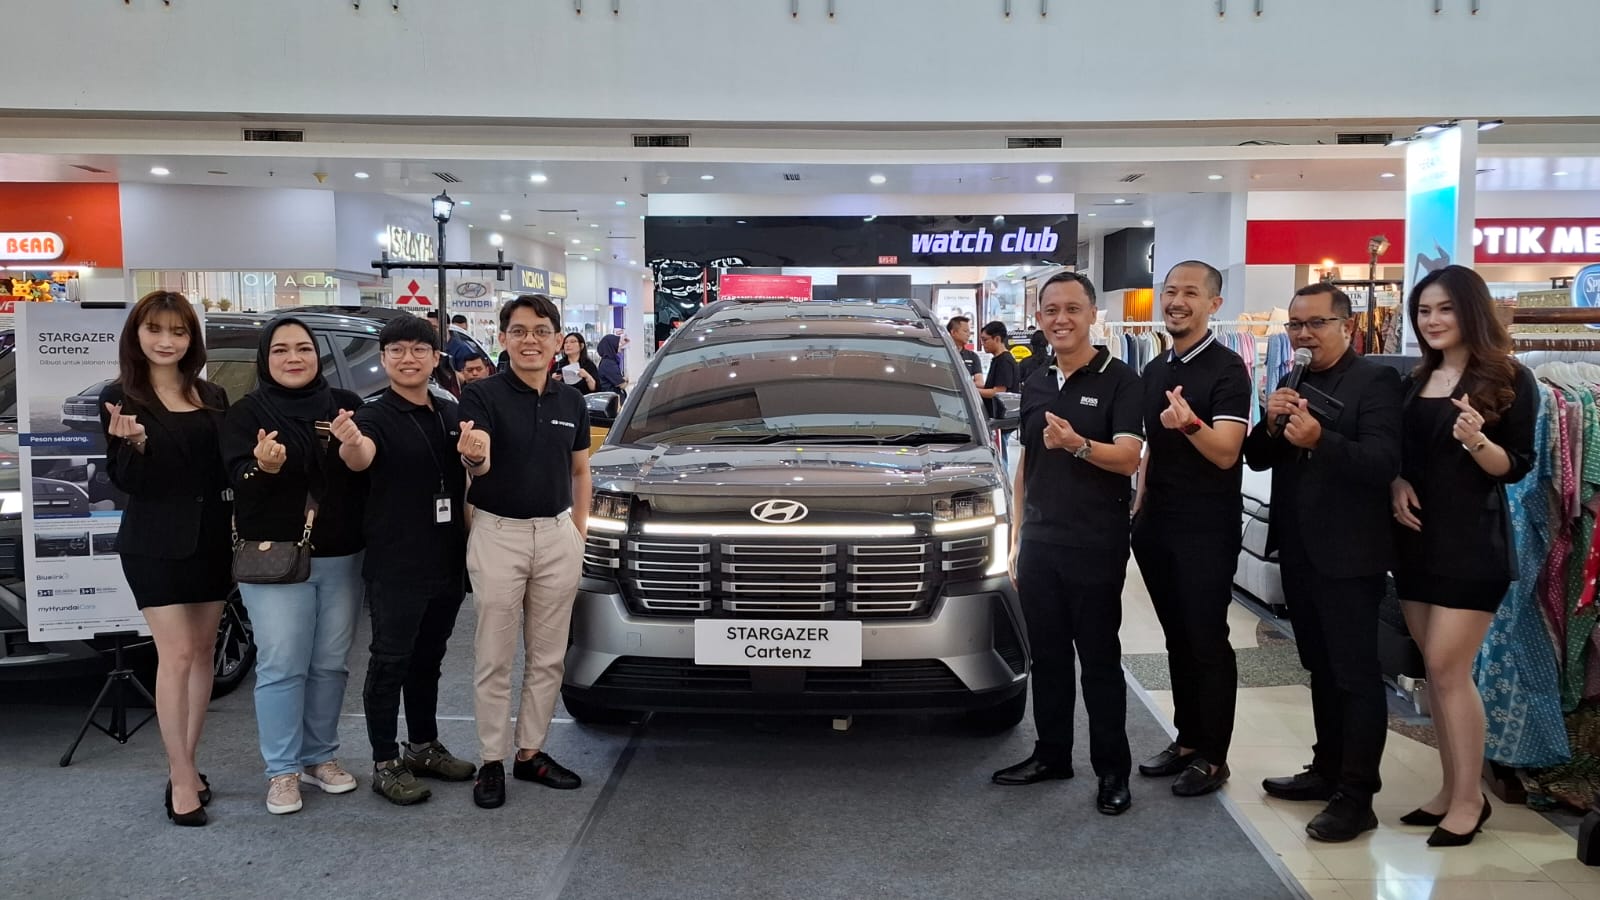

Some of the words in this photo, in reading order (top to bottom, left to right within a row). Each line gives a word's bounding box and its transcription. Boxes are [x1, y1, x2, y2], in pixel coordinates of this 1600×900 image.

[7, 237, 54, 253] BEAR
[912, 227, 994, 253] watch
[1001, 226, 1058, 252] club
[521, 269, 546, 290] NOKIA
[452, 300, 493, 308] HYUNDAI
[39, 332, 115, 342] STARGAZER
[39, 344, 89, 354] Cartenz
[726, 626, 829, 641] STARGAZER
[744, 645, 811, 659] Cartenz
